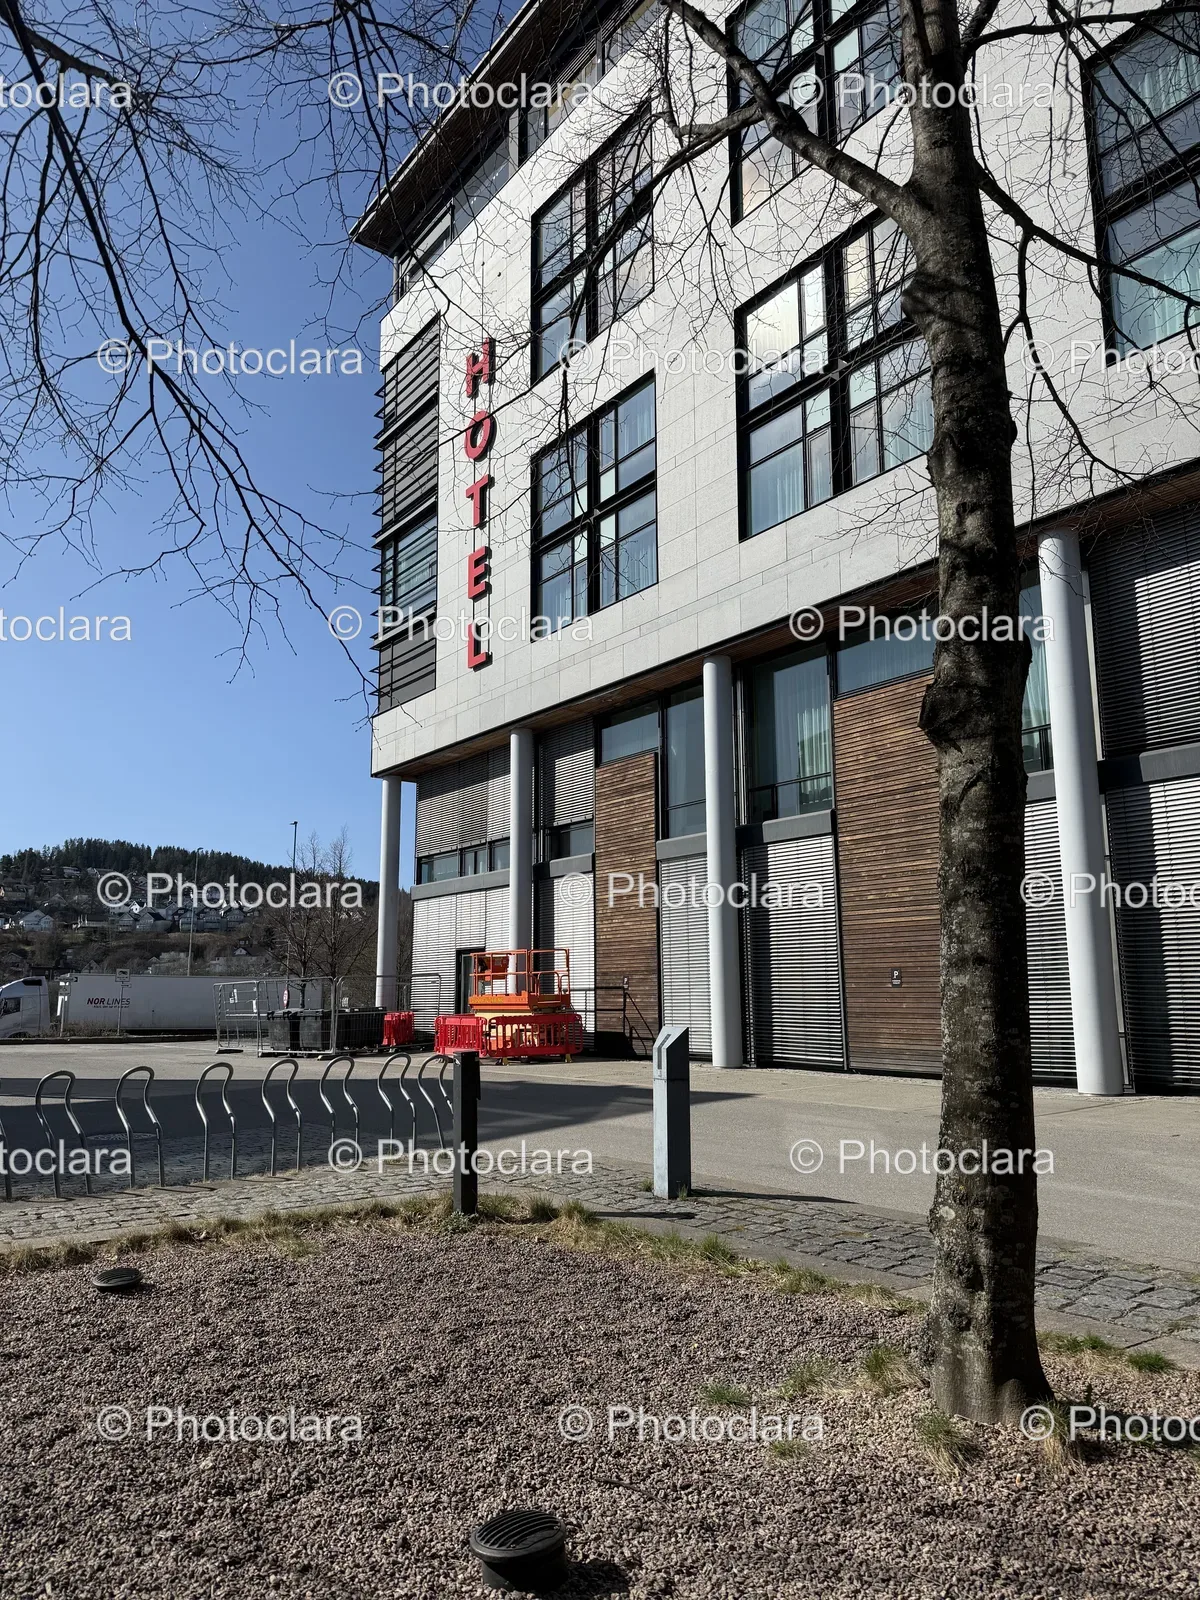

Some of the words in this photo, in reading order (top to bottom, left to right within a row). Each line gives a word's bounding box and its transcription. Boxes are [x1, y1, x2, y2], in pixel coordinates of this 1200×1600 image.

[464, 337, 495, 671] HOTEL
[87, 997, 106, 1005] NOR
[106, 997, 131, 1006] LINES
